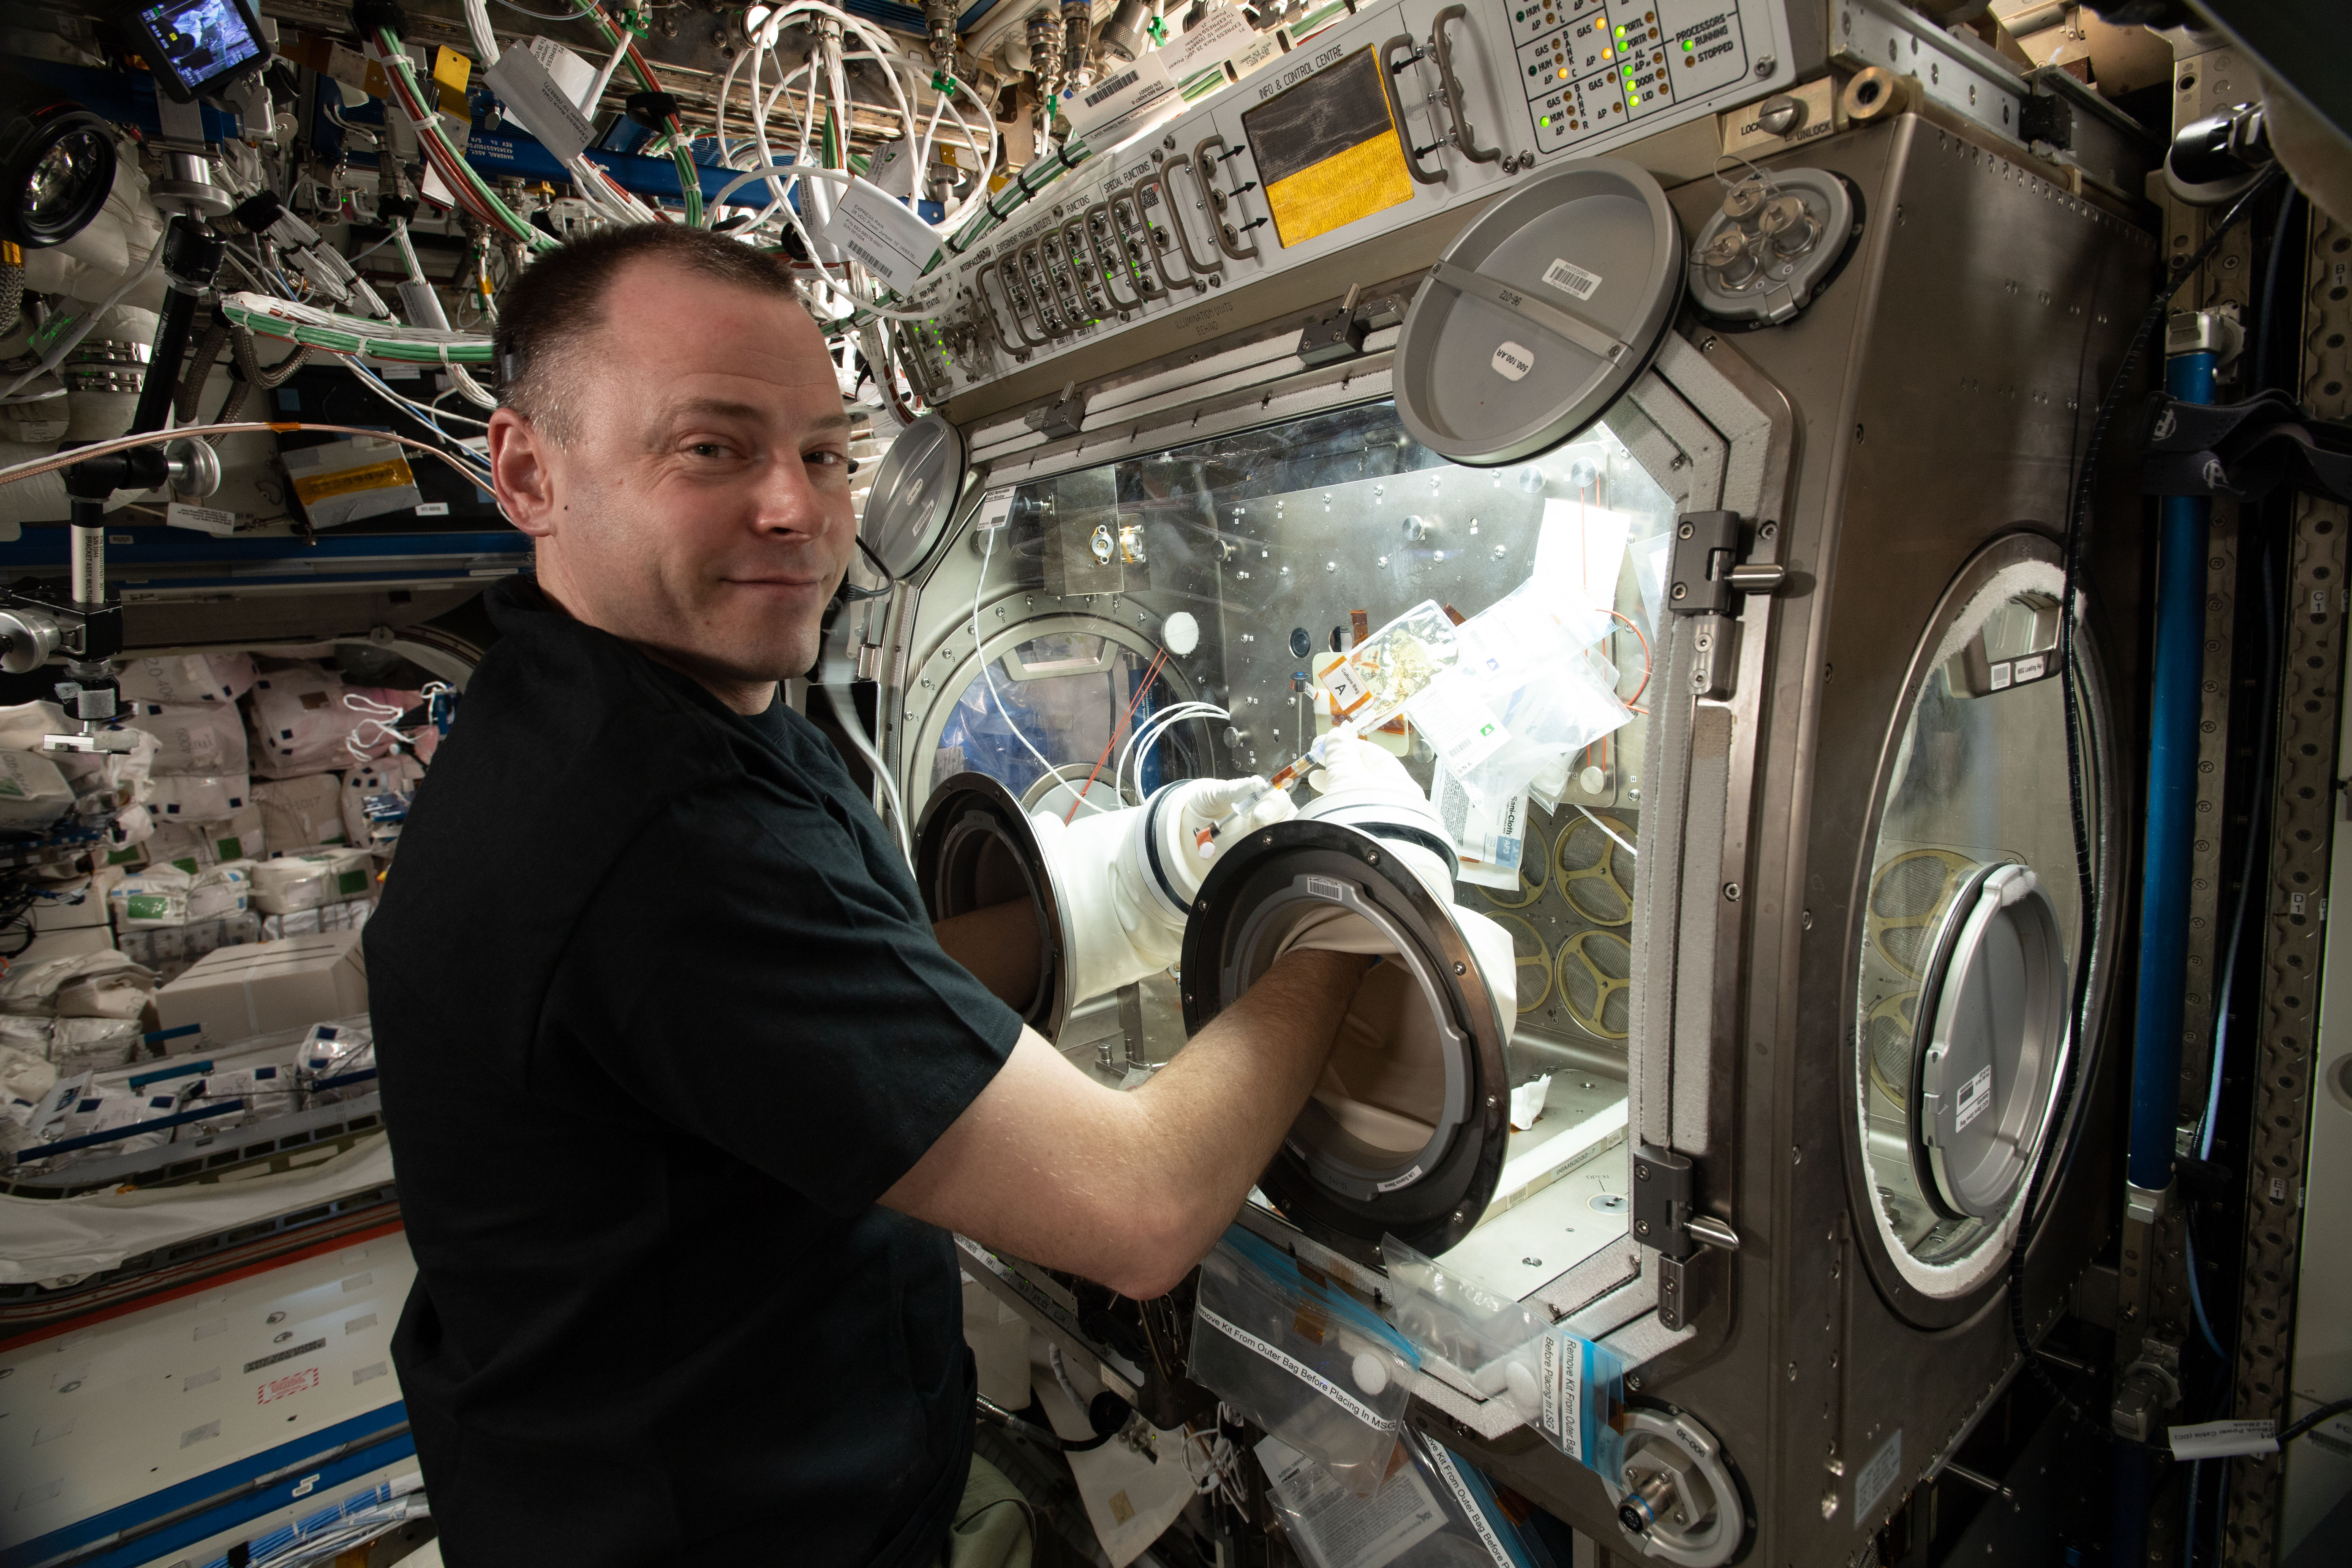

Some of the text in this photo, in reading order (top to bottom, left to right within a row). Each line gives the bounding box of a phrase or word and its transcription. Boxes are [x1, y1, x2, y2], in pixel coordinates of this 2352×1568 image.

[1211, 11, 1226, 21] Power
[1526, 4, 1540, 17] HUM
[1202, 17, 1226, 34] EXPRESS
[1215, 20, 1232, 33] Jumper
[1217, 22, 1241, 39] EXPRESS
[1577, 25, 1591, 37] GAS
[1676, 14, 1725, 42] PROCESSORS
[1186, 34, 1201, 46] Locker
[1203, 37, 1216, 46] Rack
[1695, 25, 1727, 46] RUNNING
[1186, 37, 1206, 52] (W8576)
[1535, 45, 1549, 57] GAS
[1698, 41, 1733, 62] STOPPED
[541, 45, 550, 62] Jumper
[546, 44, 558, 67] EXPRESS
[1185, 51, 1196, 59] VDC
[1636, 49, 1645, 60] AL
[1169, 58, 1184, 69] Power
[1538, 59, 1552, 72] HUM
[1259, 44, 1343, 99] INFO & CONTROL CENTRE
[1096, 75, 1118, 90] 00060851M
[1589, 79, 1603, 90] GAS
[1636, 74, 1654, 88] DOOR
[1132, 90, 1155, 104] 683-44267-3
[1139, 85, 1153, 95] 000001
[1642, 90, 1653, 101] LID
[544, 82, 588, 131] Jumper (W8577)
[1547, 97, 1560, 108] GAS
[542, 89, 588, 140] EXPRESS Rack Data
[1550, 111, 1564, 122] HUM
[1102, 122, 1118, 133] Cable
[1795, 122, 1830, 140] UNLOCK
[1104, 161, 1150, 193] SPECIAL FUNCTIONS
[1067, 198, 1089, 214] FUNCTIONS
[855, 204, 884, 229] EXPRESS Rack
[1034, 217, 1051, 232] OUTLETS
[1122, 220, 1132, 228] RESET
[851, 229, 864, 241] 001004
[854, 225, 882, 248] 683-98576-0001
[858, 213, 866, 221] VDC
[867, 220, 878, 231] Power
[879, 231, 893, 242] Jumper
[899, 246, 915, 259] (W8576)
[1106, 239, 1115, 247] ILLUM
[1140, 262, 1151, 272] REMOTE
[926, 297, 940, 308] STATUS
[1499, 290, 1522, 306] 96-072
[1175, 302, 1233, 329] ILLUMINATION UNITS
[1078, 328, 1086, 336] OUTLET
[1196, 321, 1218, 335] BEHIND
[1497, 349, 1528, 372] 500.100.AR
[2314, 592, 2323, 600] C
[2316, 603, 2319, 611] 1
[1342, 669, 1353, 684] Culture
[1304, 689, 1312, 699] TOOL
[1334, 682, 1349, 696] A
[2294, 894, 2303, 902] D
[2275, 1179, 2282, 1189] E
[985, 1257, 994, 1266] FAN
[1222, 1323, 1397, 1431] Kit From Outer Bag Before Placing In MSG
[1543, 1337, 1554, 1430] Before Placing In LSG
[1564, 1340, 1576, 1455] Remove Kit From Outer Bag
[1677, 1429, 1705, 1457] 01-006
[1437, 1452, 1503, 1561] Kit From Outer Bag Before
